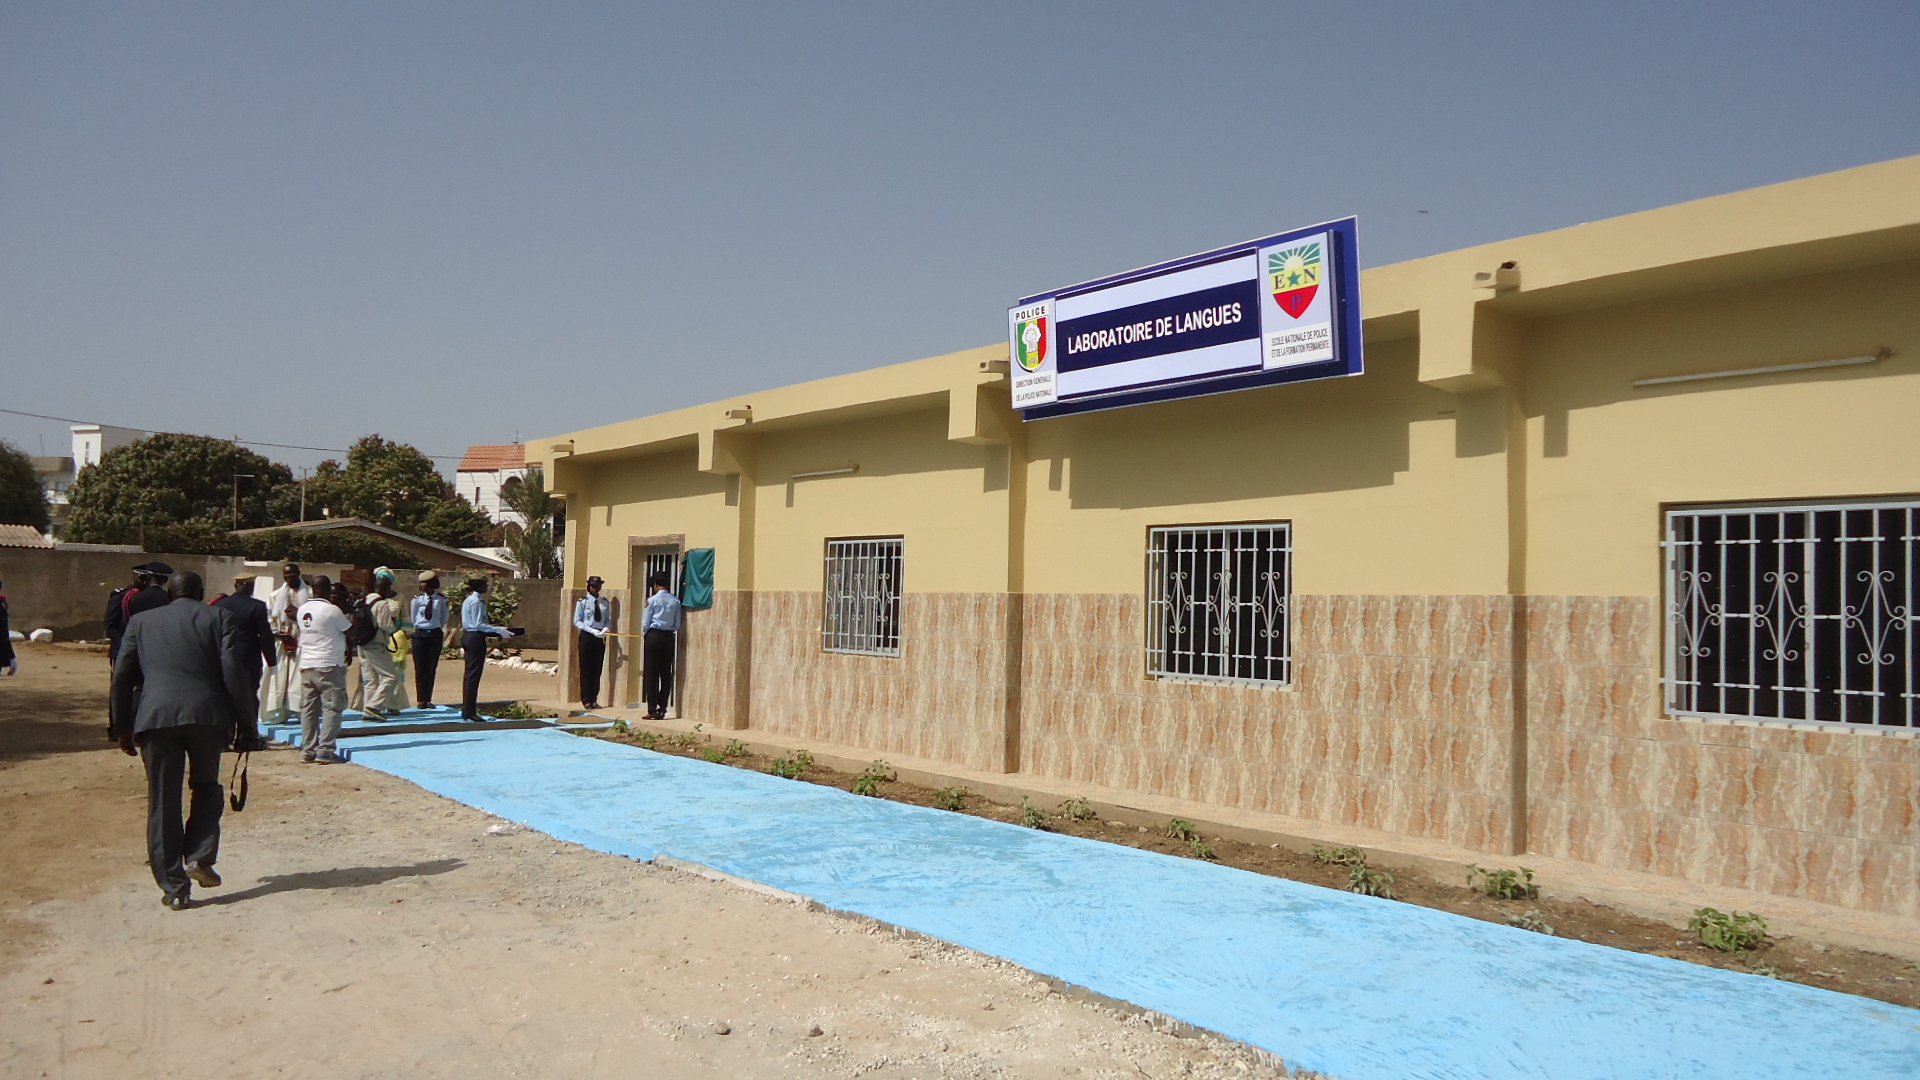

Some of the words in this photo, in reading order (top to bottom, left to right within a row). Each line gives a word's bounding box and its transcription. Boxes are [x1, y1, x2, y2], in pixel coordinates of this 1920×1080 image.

[1274, 274, 1285, 290] E
[1304, 267, 1316, 284] N
[1292, 294, 1303, 310] P
[1015, 305, 1046, 321] POLICE
[1068, 320, 1153, 355] LABORATOIRE
[1155, 316, 1173, 338] DE
[1175, 302, 1242, 334] LANGUES
[1272, 336, 1285, 346] ECOLE
[1285, 332, 1307, 343] NATIONALE
[1307, 331, 1313, 340] DE
[1314, 328, 1328, 339] POLICE
[1271, 349, 1276, 358] ET
[1276, 348, 1281, 357] DE
[1281, 347, 1286, 357] LA
[1286, 344, 1306, 355] FORMATION
[1306, 340, 1329, 351] PERMANENTE
[1016, 378, 1033, 389] DIRECTION
[1033, 374, 1051, 385] GENERALE
[1016, 394, 1021, 402] DE
[1021, 393, 1025, 401] LA
[1025, 391, 1036, 400] POLICE
[1035, 388, 1052, 398] NATIONALE
